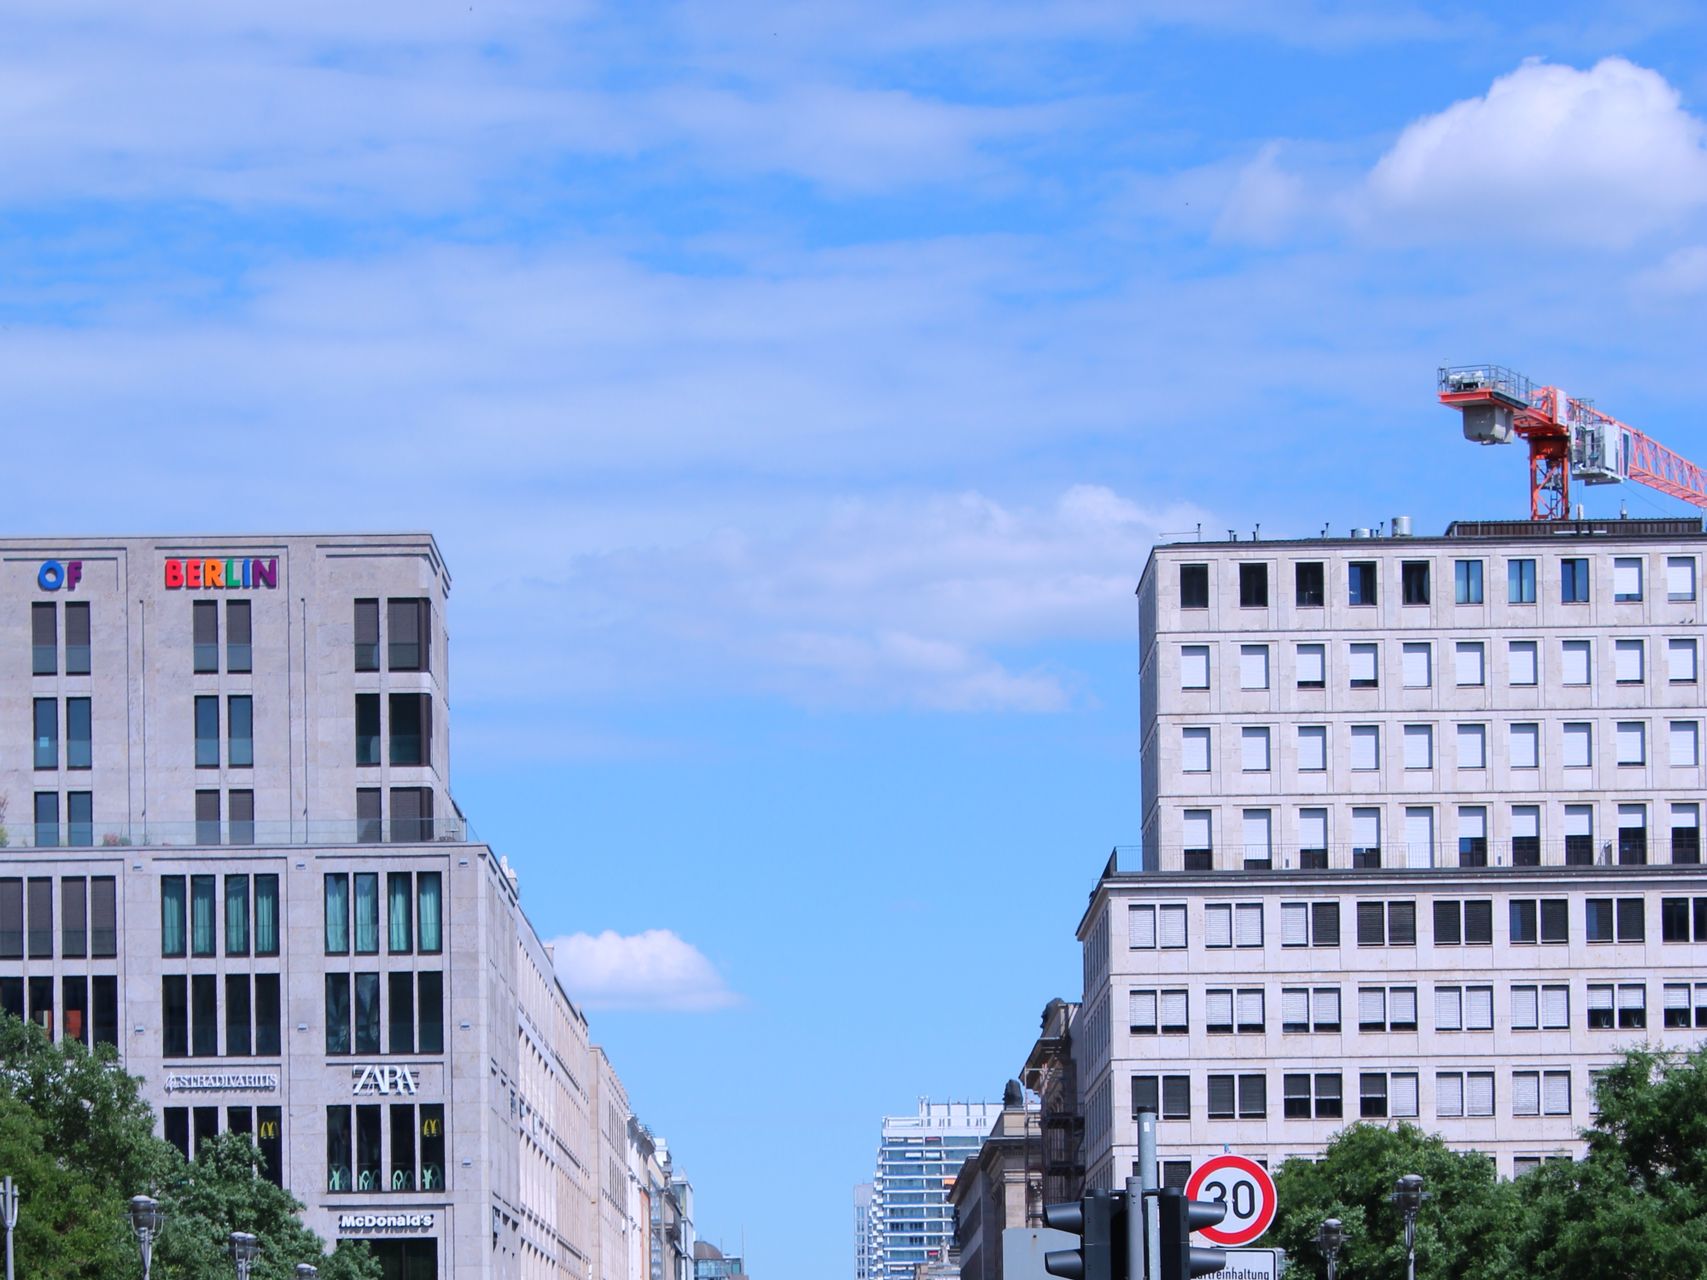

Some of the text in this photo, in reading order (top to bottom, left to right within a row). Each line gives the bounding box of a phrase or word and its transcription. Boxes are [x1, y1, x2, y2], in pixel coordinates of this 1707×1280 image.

[38, 559, 277, 590] OF BERLIN
[179, 1074, 278, 1088] STRADIVARIUS
[352, 1064, 417, 1095] ZARA
[1205, 1180, 1256, 1219] 30
[341, 1215, 432, 1228] McDonald's
